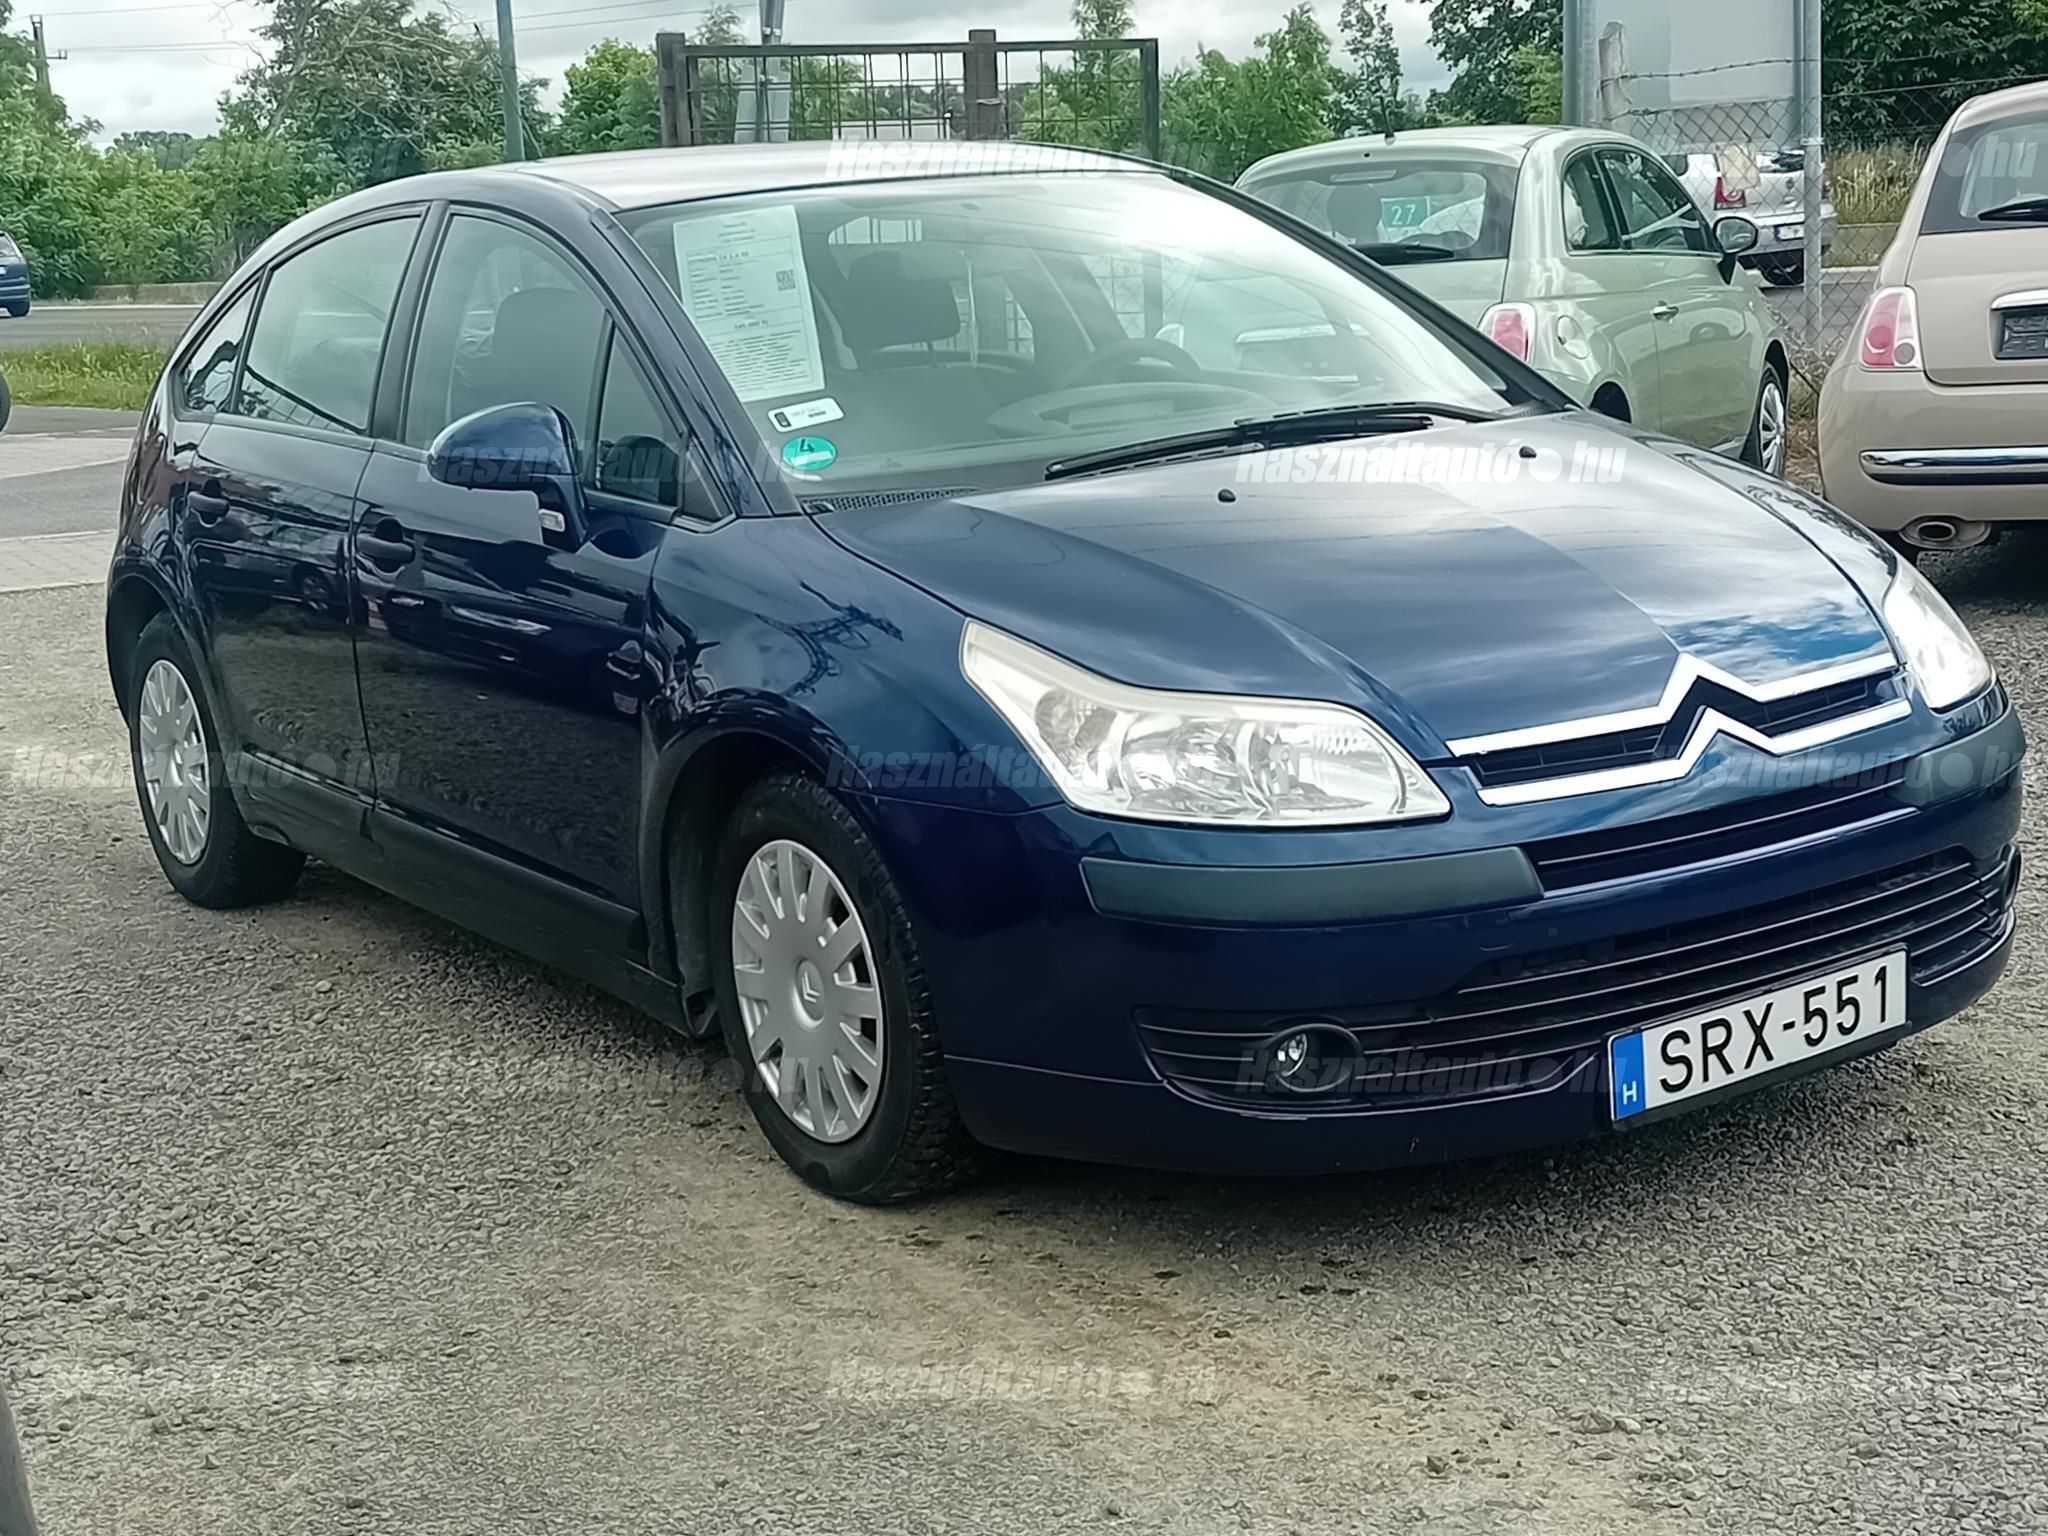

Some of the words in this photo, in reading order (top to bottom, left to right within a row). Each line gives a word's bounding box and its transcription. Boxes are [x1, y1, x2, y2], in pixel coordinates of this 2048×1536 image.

[1391, 204, 1416, 226] 27
[800, 438, 815, 453] 4
[1659, 965, 1888, 1093] SRX-551
[1622, 1081, 1637, 1105] H
